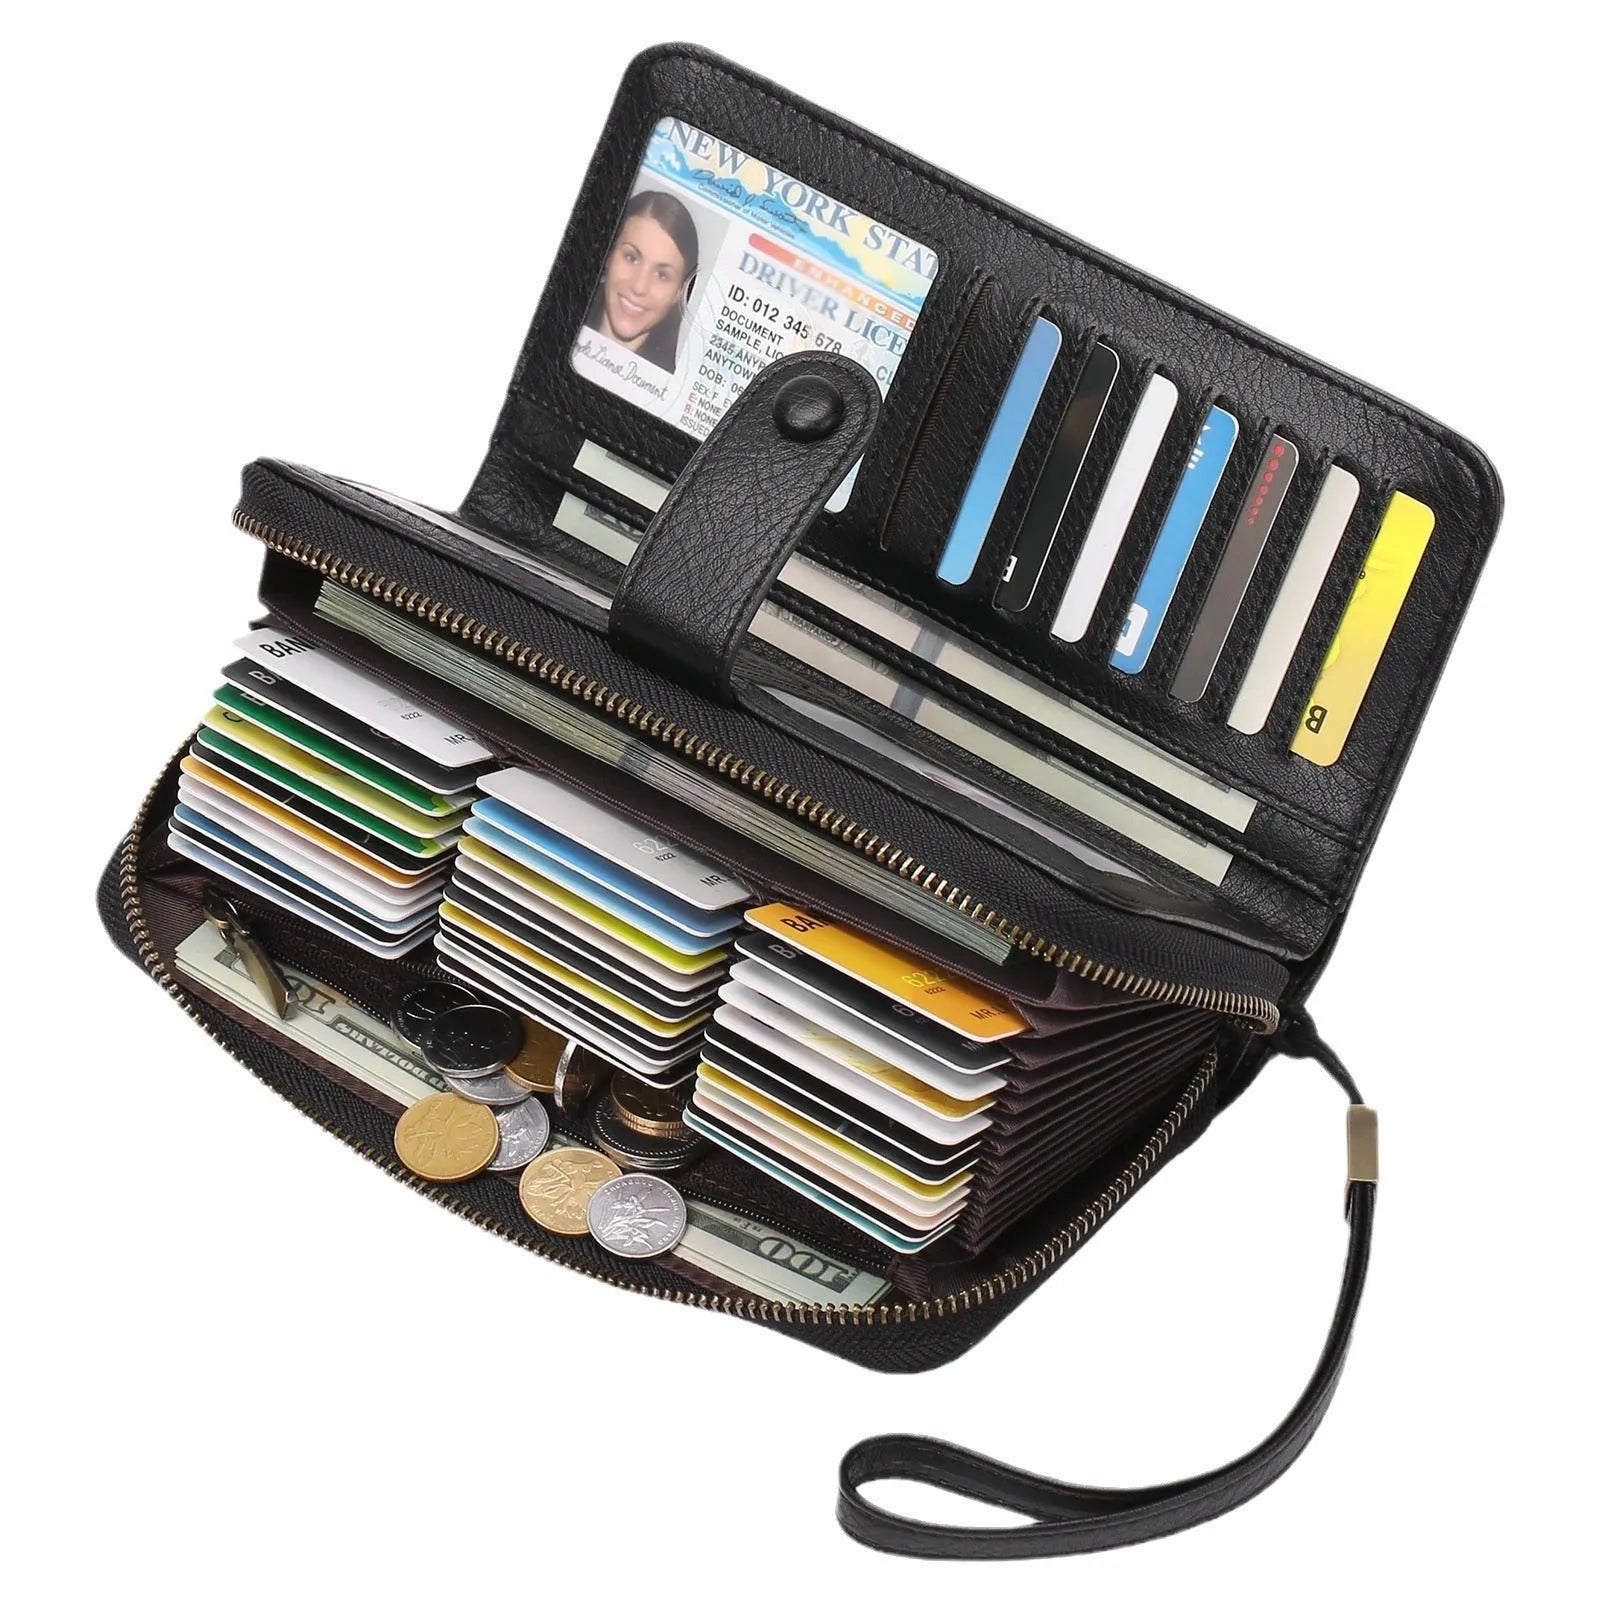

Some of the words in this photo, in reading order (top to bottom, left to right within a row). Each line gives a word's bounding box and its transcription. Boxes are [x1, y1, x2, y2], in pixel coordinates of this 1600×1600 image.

[667, 120, 750, 175] NEW
[762, 165, 858, 236] YORK
[750, 210, 770, 225] Motor
[738, 252, 839, 320] DRIVER
[720, 305, 784, 346] DOCUMENT
[728, 284, 750, 306] ID:
[752, 298, 780, 323] 012
[783, 315, 810, 339] 345
[815, 332, 842, 354] 678
[709, 334, 735, 356] 2345
[716, 319, 762, 353] SAMPLE,
[698, 364, 726, 387] DOB:
[694, 409, 719, 428] NONE
[698, 397, 721, 417] NONE
[680, 415, 710, 437] ISSUED
[780, 915, 829, 933] BA
[335, 1021, 427, 1081] DOLLARS
[759, 1236, 850, 1284] 100
